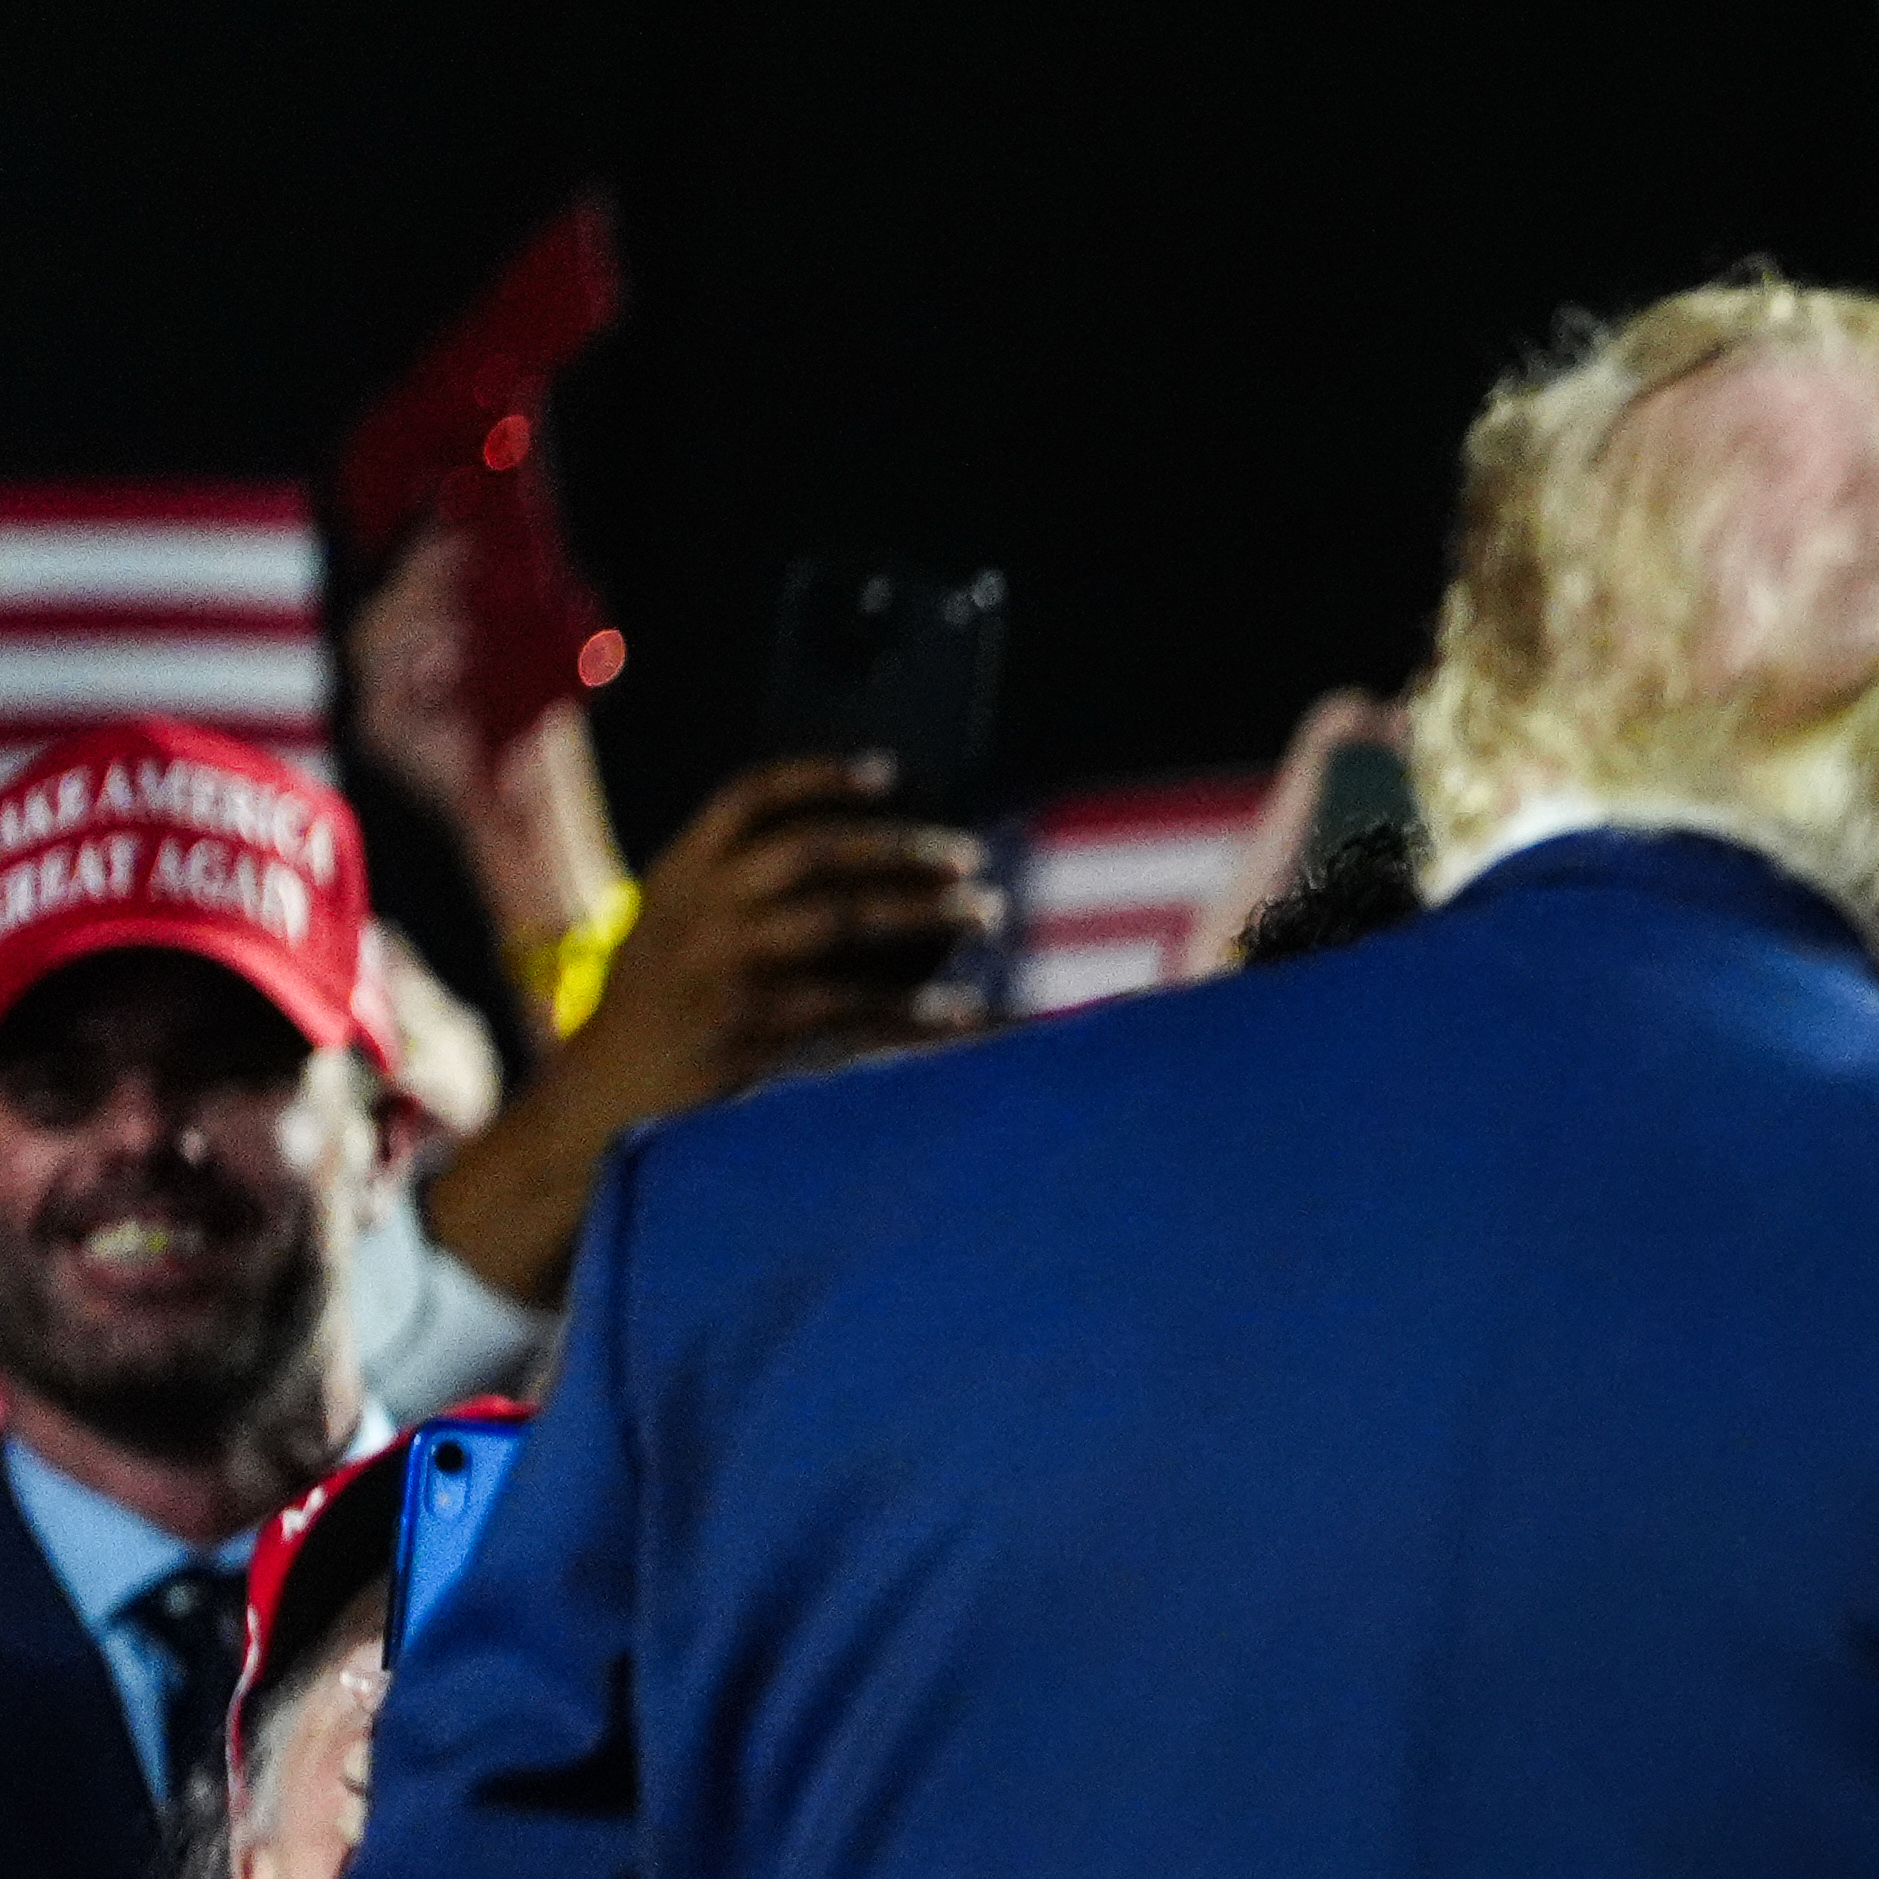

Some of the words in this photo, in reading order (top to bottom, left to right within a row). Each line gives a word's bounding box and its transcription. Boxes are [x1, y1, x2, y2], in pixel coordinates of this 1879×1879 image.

[0, 764, 92, 849] AKE
[99, 756, 336, 888] AMERICA
[0, 832, 141, 938] REAT
[149, 834, 311, 950] AGAIN
